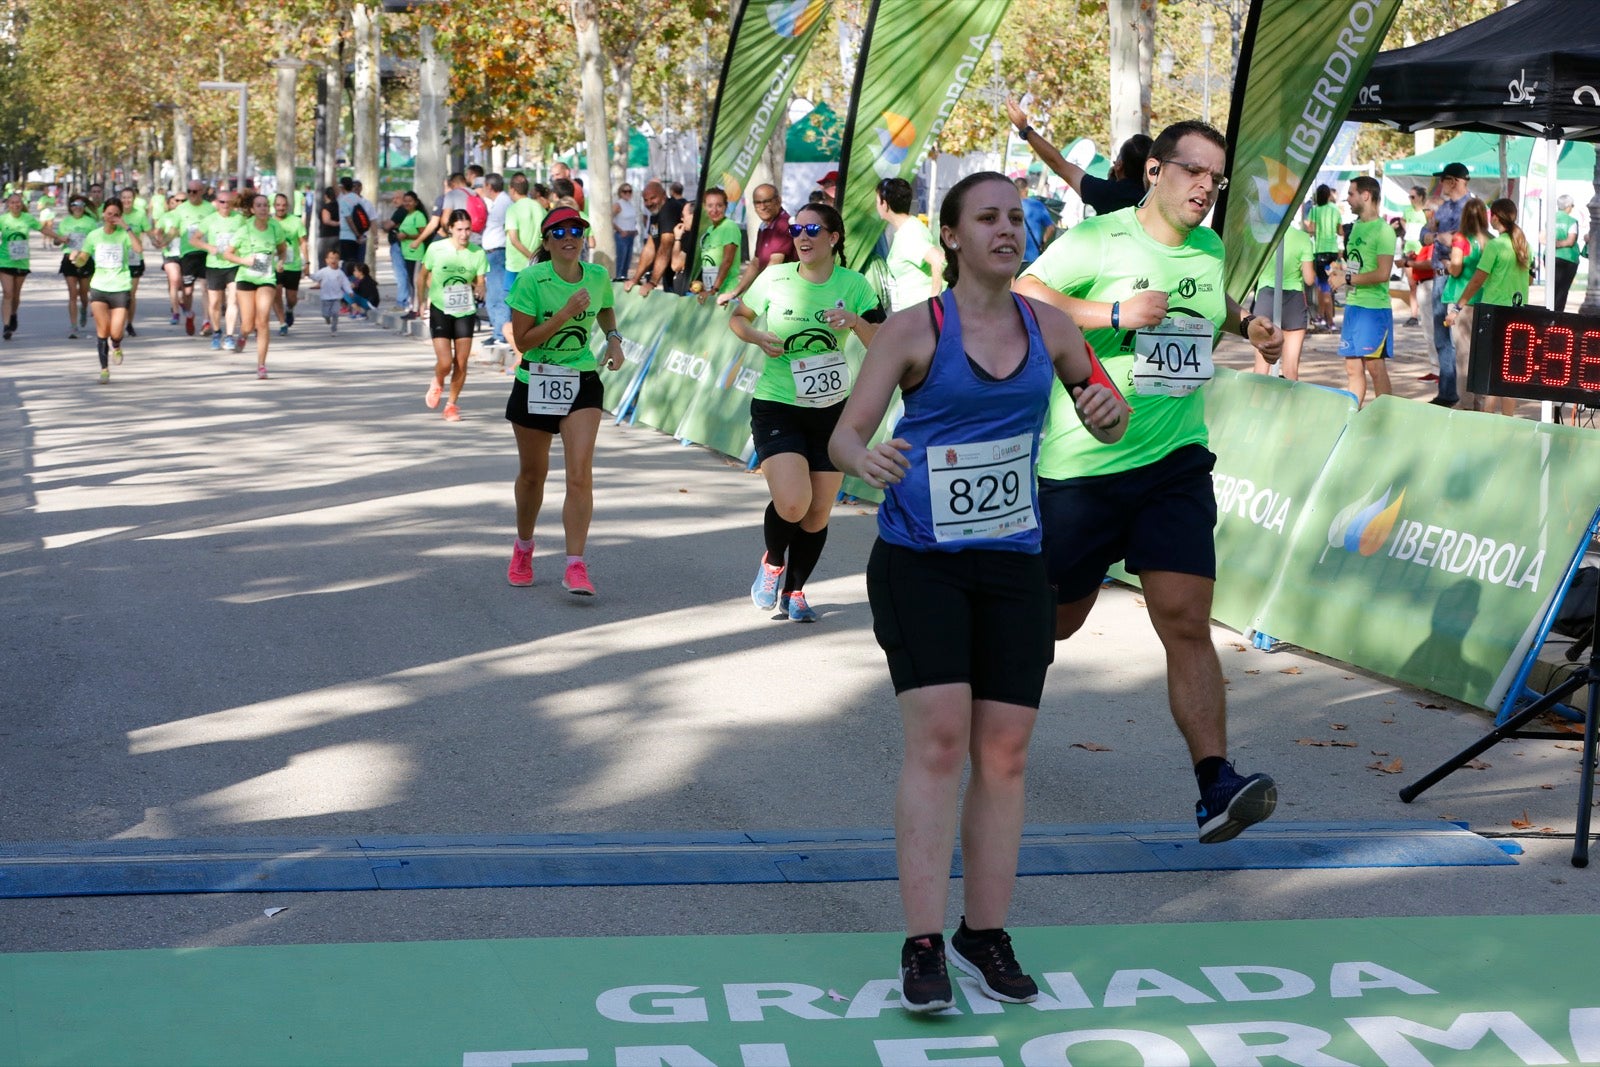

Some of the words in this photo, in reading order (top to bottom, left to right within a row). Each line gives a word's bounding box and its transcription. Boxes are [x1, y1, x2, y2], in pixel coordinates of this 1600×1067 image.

[1285, 0, 1383, 166] IBERDRO
[733, 53, 796, 178] IBERDROLA
[448, 293, 469, 306] 578
[1145, 342, 1202, 373] 404
[538, 380, 574, 401] 185
[802, 370, 842, 396] 238
[949, 470, 1020, 515] 829
[1388, 519, 1547, 592] IBERDROLA
